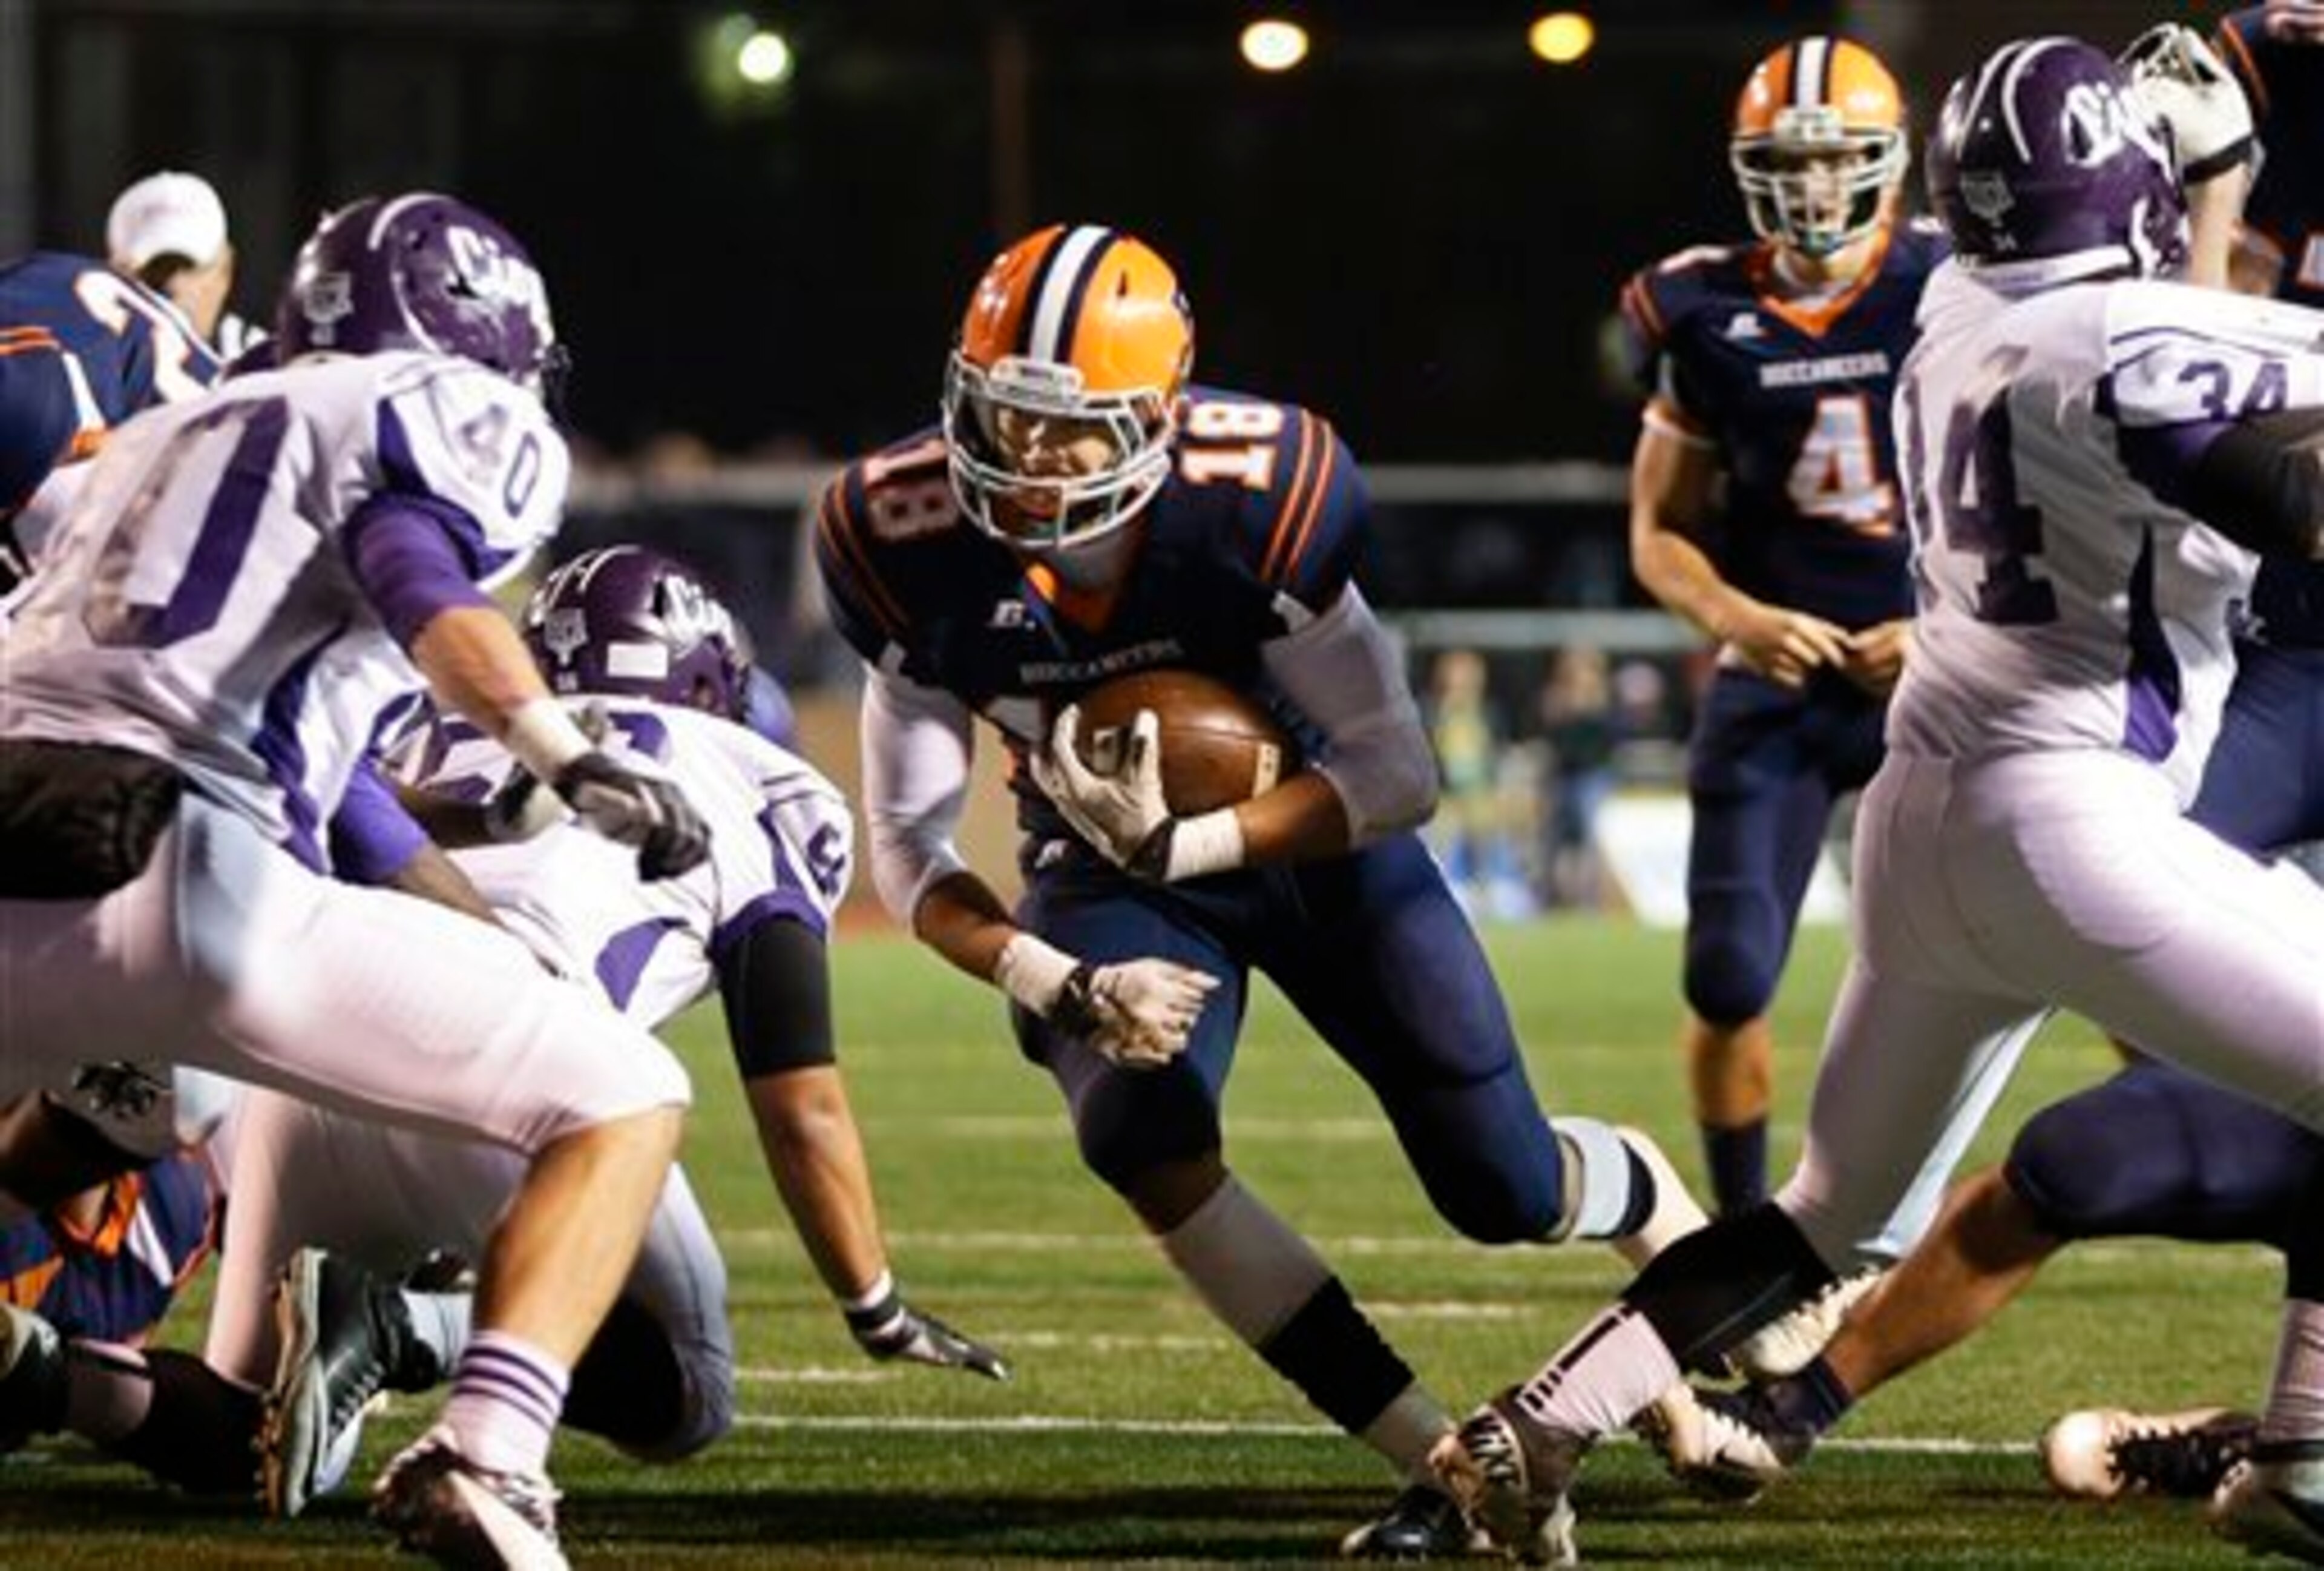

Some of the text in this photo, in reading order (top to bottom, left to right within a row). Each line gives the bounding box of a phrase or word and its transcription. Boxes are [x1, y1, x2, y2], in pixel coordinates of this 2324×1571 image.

[2178, 360, 2289, 421] 34
[862, 437, 959, 536] 18
[1182, 402, 1284, 492] 18
[1784, 396, 1893, 533] 4
